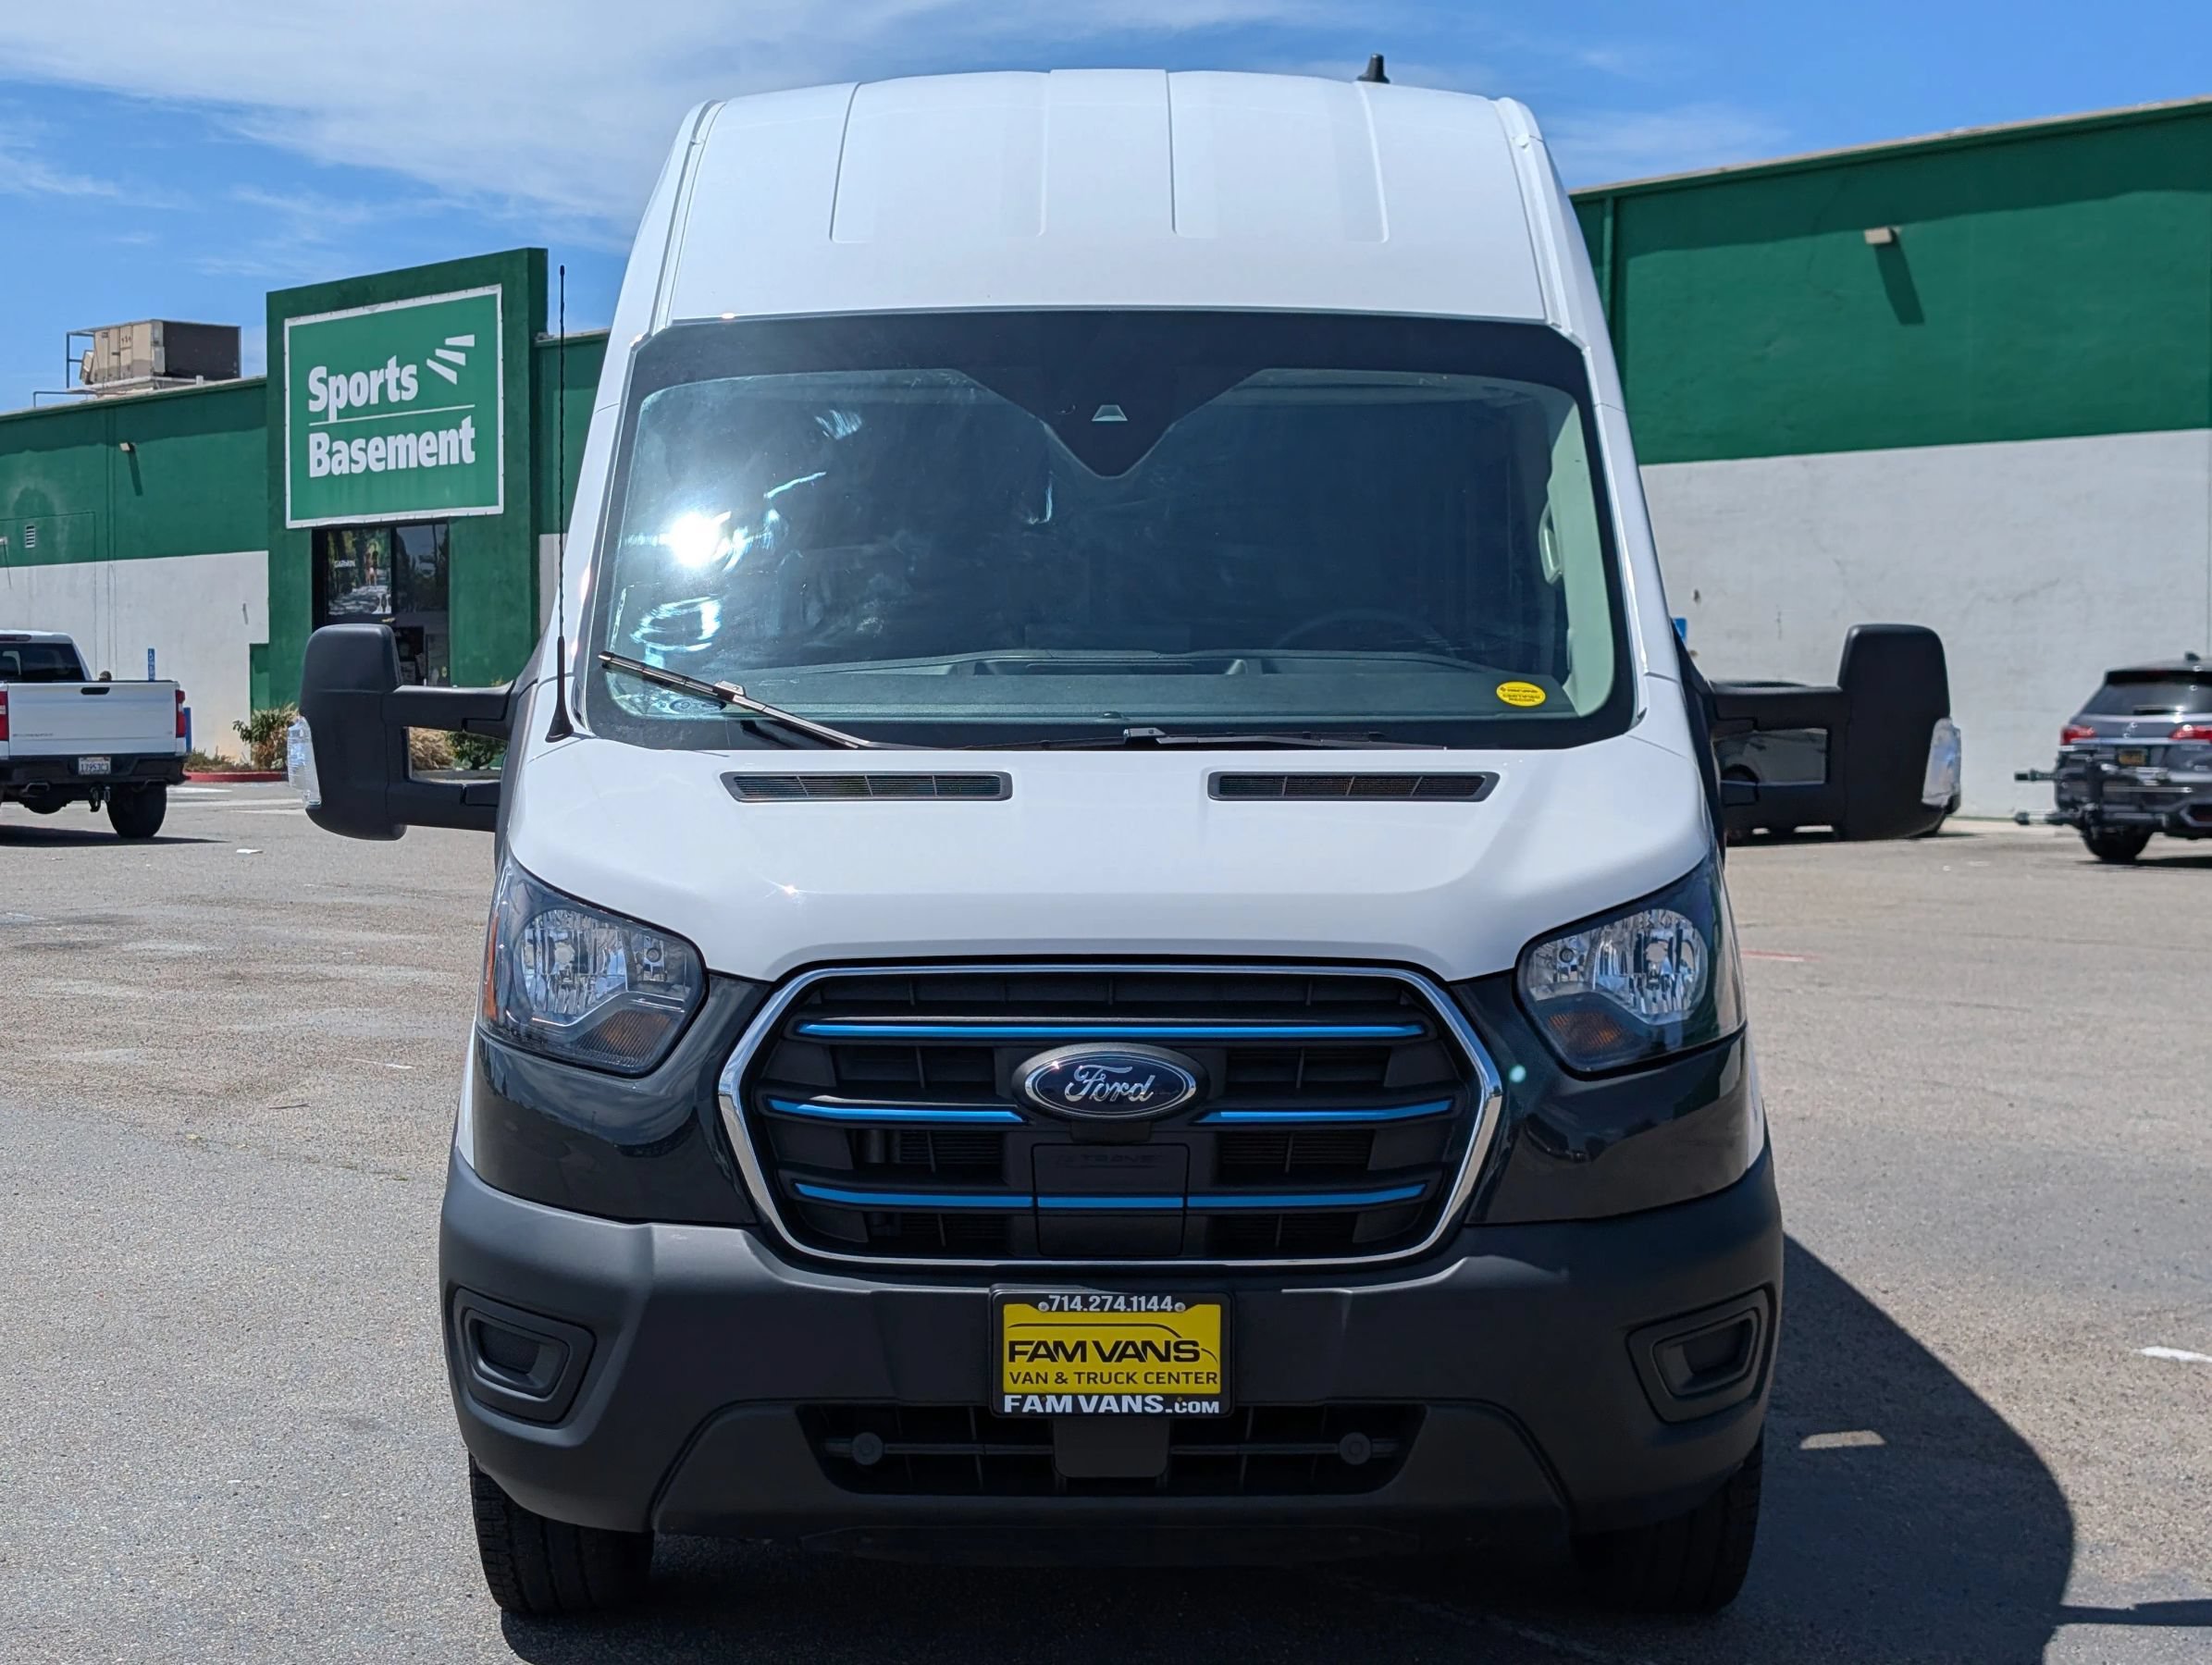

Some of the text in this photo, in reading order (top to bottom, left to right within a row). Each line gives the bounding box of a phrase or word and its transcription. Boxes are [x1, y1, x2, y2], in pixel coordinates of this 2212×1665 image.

[308, 354, 418, 423] Sports
[309, 414, 476, 478] Basement
[1064, 1064, 1155, 1103] Ford
[1048, 1295, 1173, 1313] 714.274.1144
[1007, 1339, 1201, 1363] FAM VANS
[1009, 1371, 1218, 1386] VAN & TRUCK CENTER
